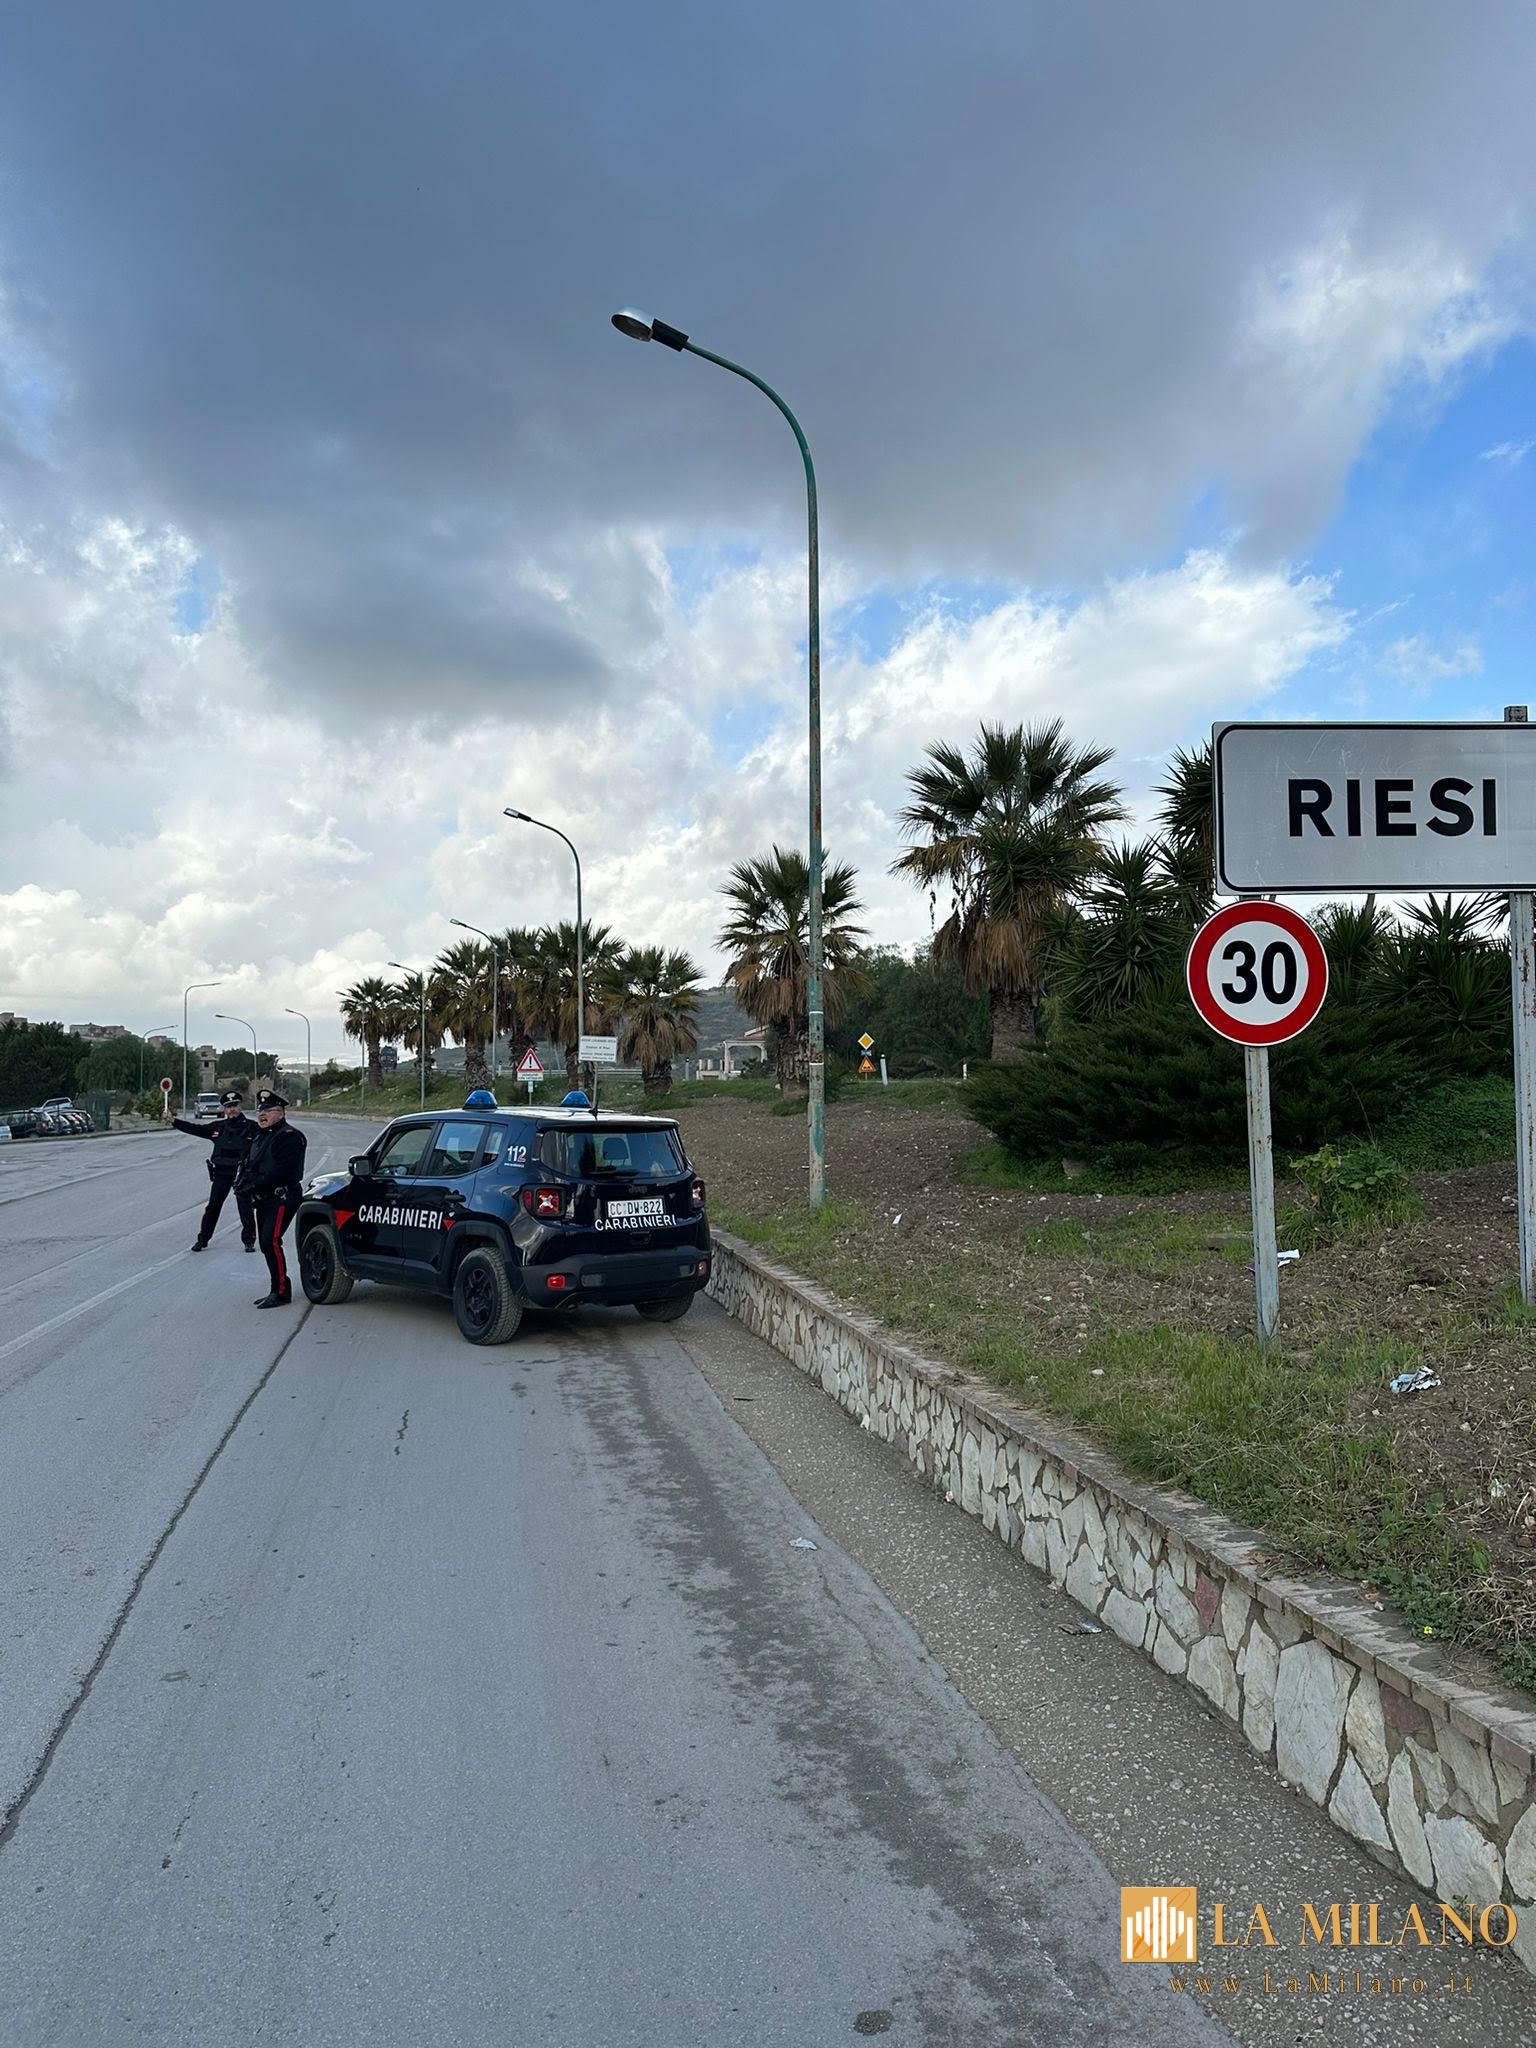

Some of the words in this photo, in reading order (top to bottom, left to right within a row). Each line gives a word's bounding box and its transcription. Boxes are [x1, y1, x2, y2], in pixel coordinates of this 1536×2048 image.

[1287, 777, 1497, 838] RIESI
[1221, 940, 1298, 1005] 30
[507, 1145, 527, 1163] 112
[358, 1204, 443, 1230] CARABINIERI
[594, 1214, 677, 1231] CARABINIERI
